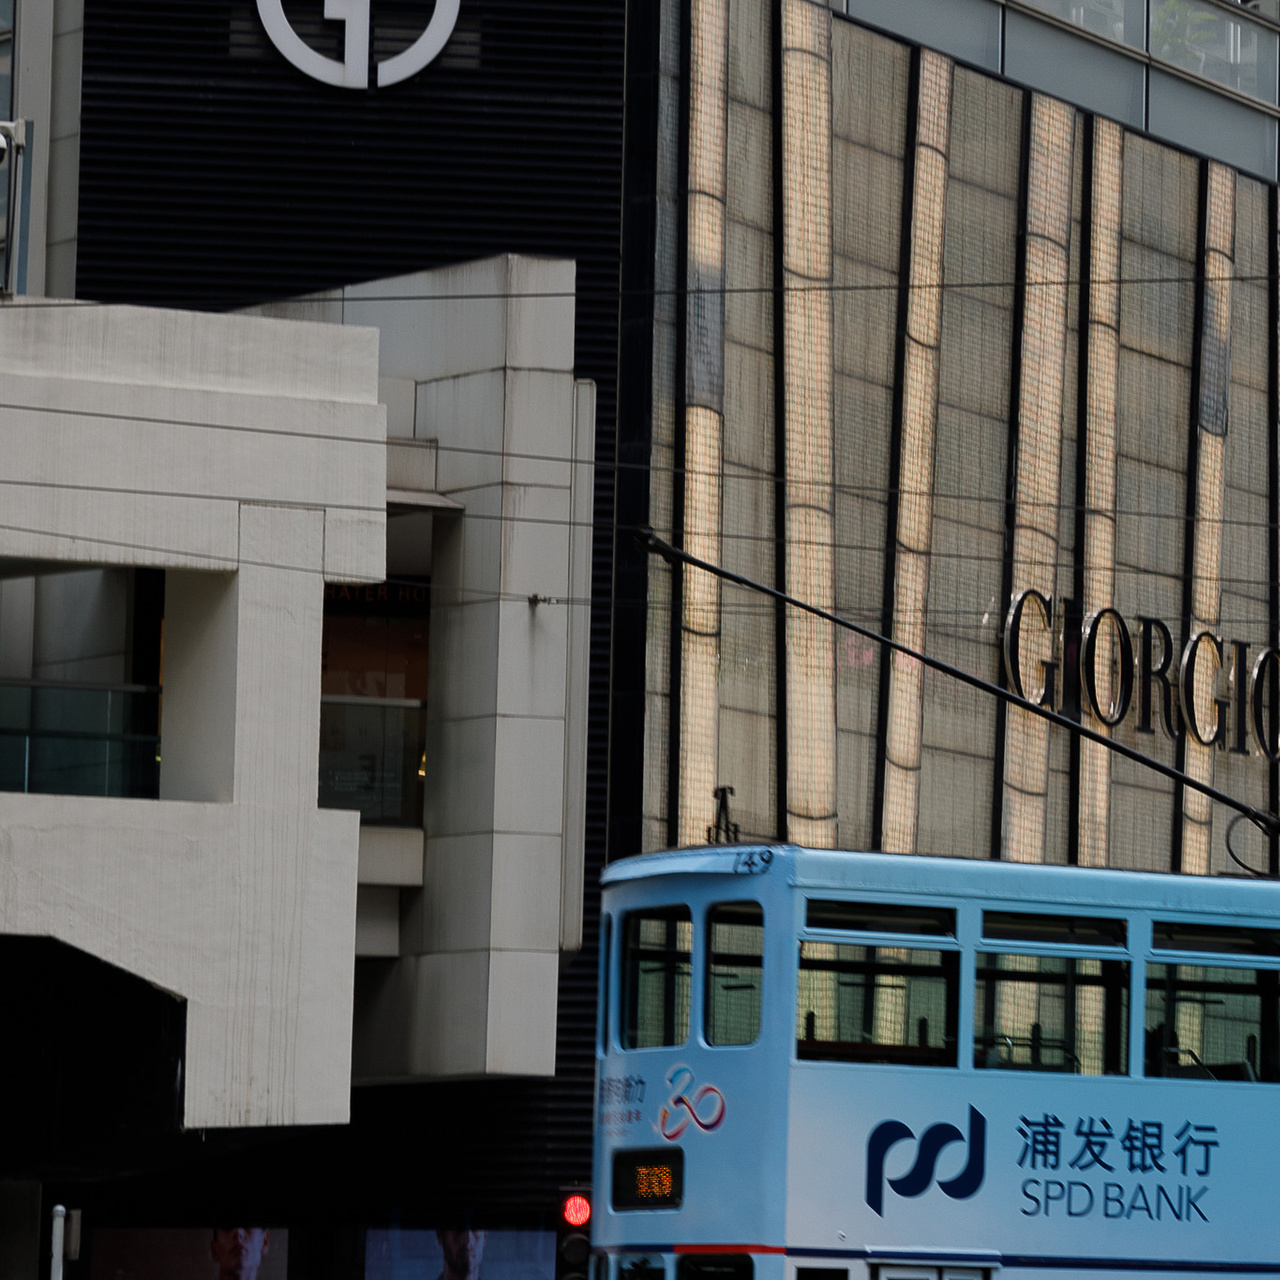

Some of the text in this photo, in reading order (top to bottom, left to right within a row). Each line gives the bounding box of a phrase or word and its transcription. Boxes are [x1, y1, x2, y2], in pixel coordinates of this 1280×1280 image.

[733, 850, 774, 874] 149
[1015, 1112, 1220, 1176] 浦发银行
[1019, 1178, 1210, 1223] SPD BANK
